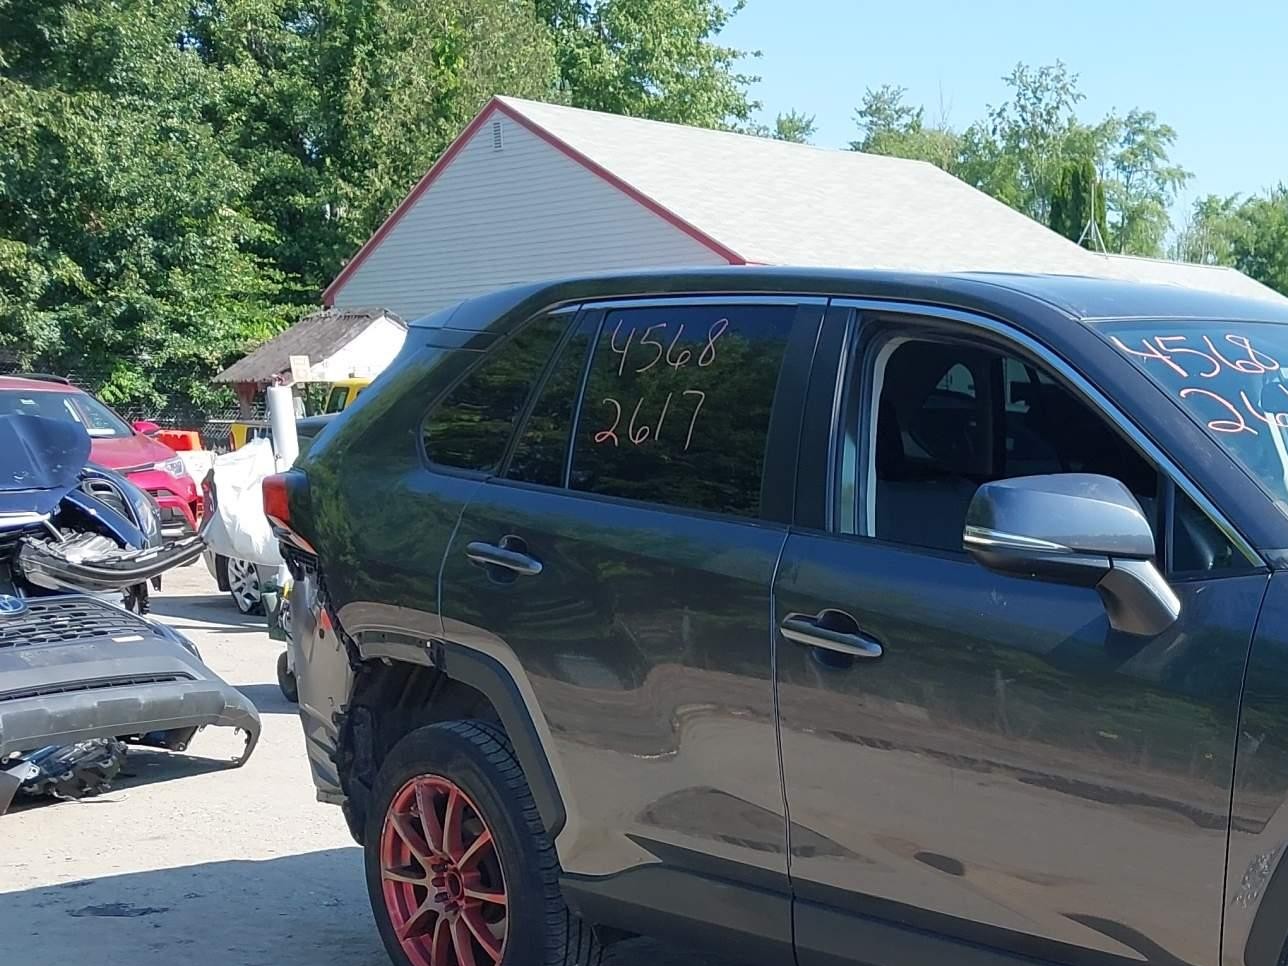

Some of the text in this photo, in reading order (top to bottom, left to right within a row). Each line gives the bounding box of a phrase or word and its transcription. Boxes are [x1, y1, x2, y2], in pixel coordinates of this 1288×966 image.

[611, 318, 729, 377] 4568
[1109, 334, 1280, 378] 4568
[594, 389, 706, 451] 2617
